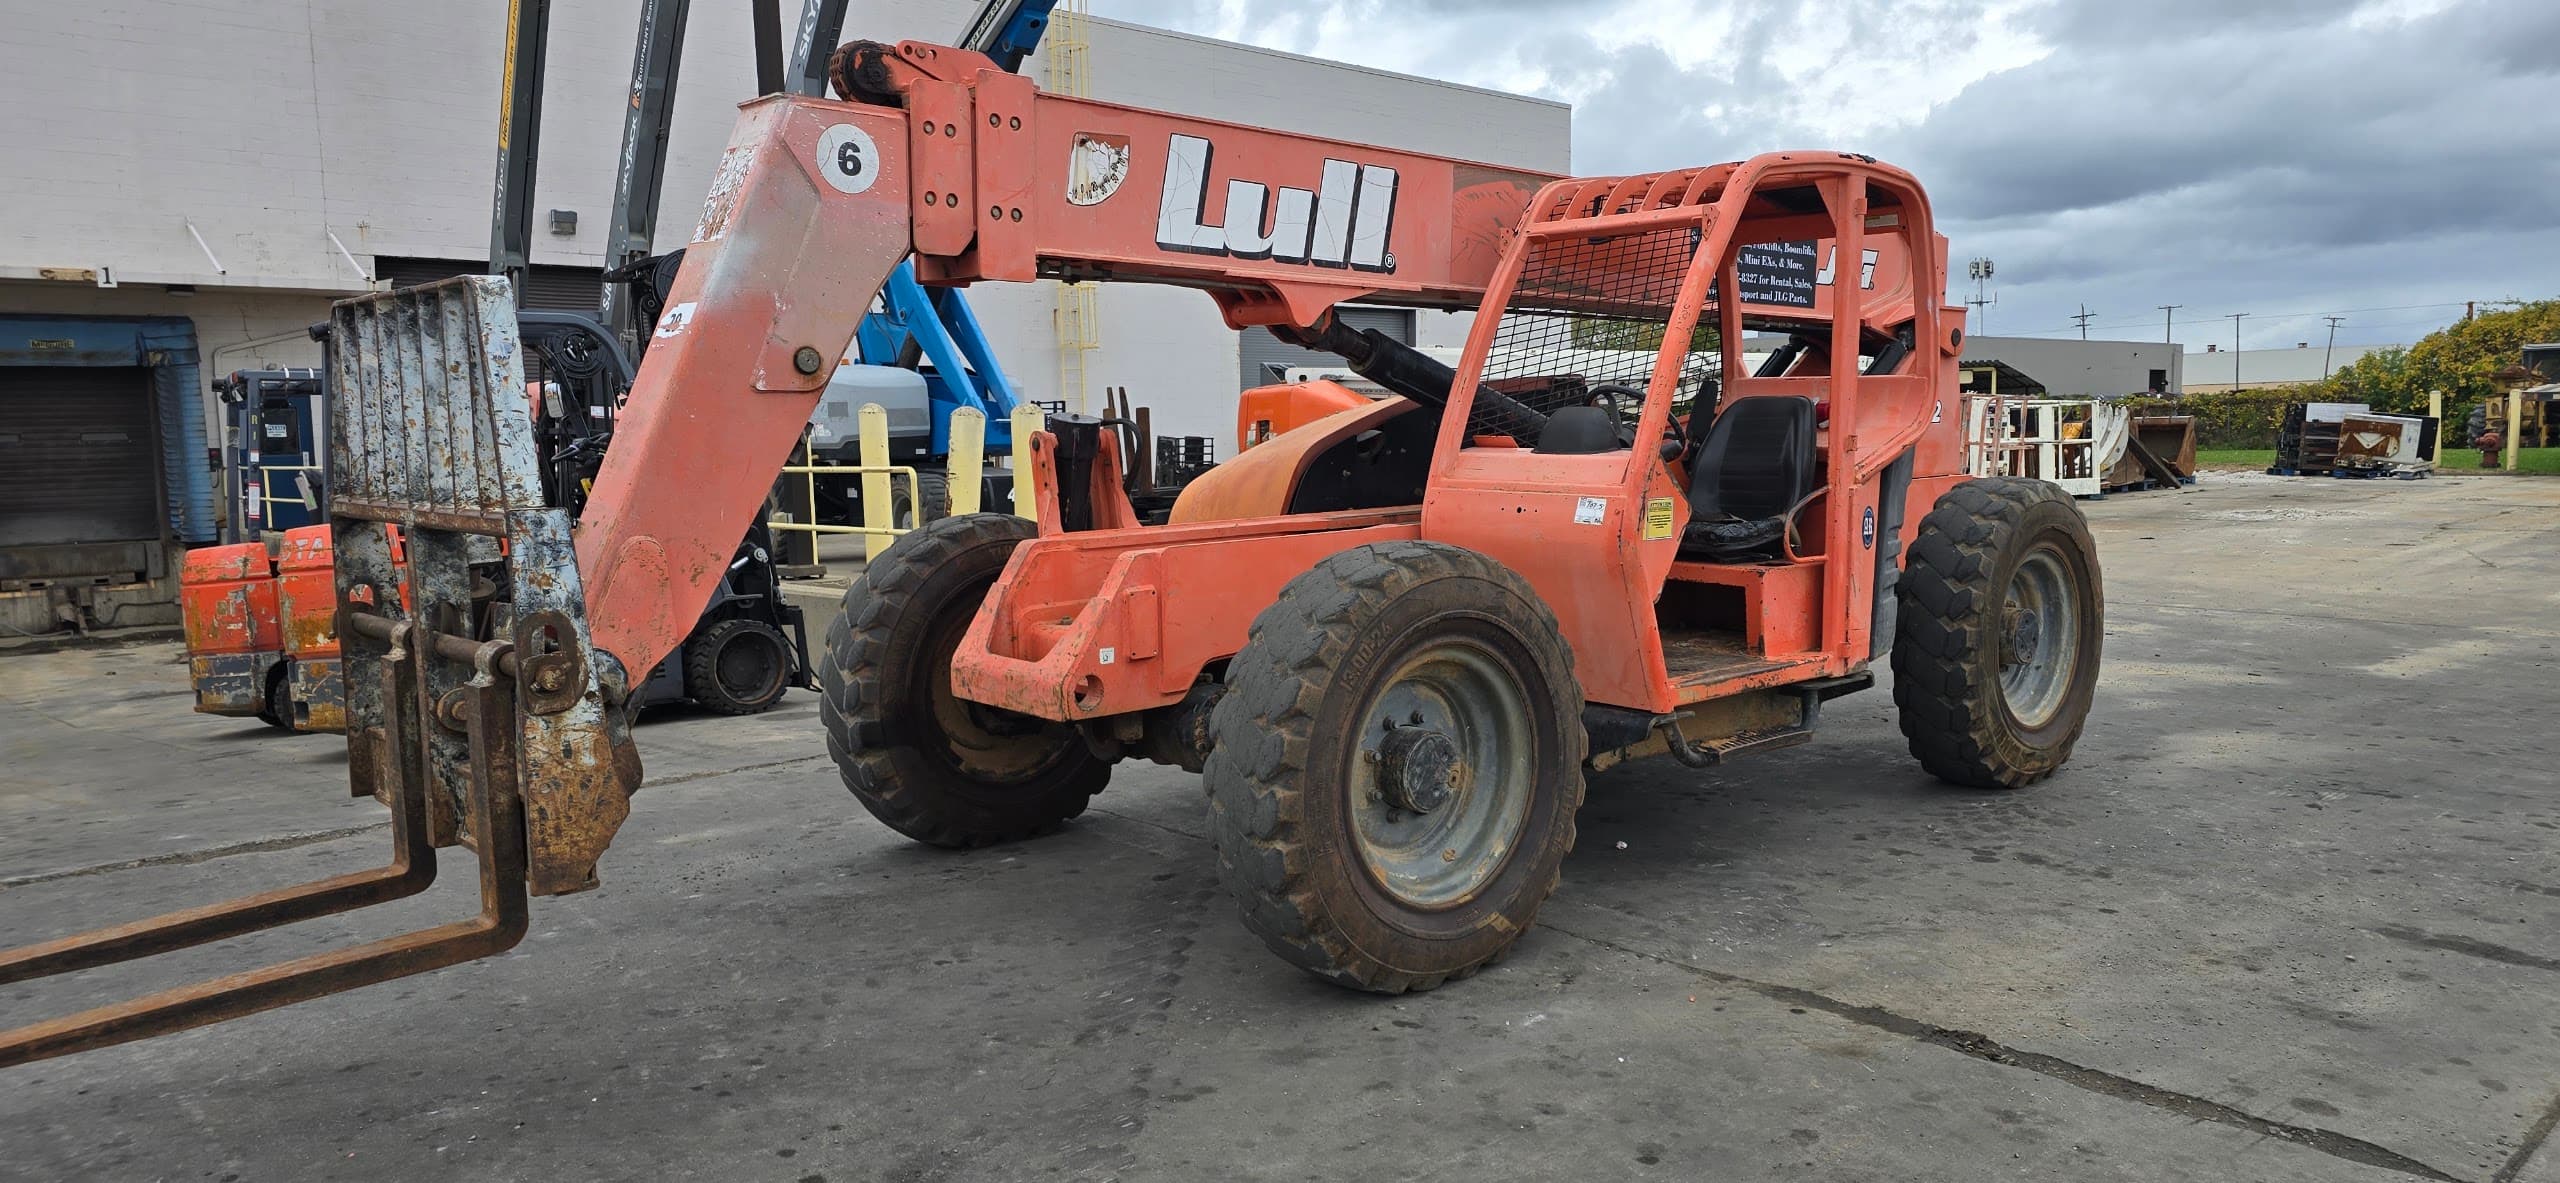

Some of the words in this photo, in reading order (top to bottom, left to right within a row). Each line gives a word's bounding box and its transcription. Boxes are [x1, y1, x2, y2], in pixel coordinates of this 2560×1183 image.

[621, 114, 638, 195] SKYJACK
[837, 141, 862, 177] 6
[496, 151, 505, 221] SKYJACK
[1155, 132, 1399, 273] Lull
[1784, 242, 1817, 257] Boomlifts,
[1744, 253, 1760, 265] Mini
[1778, 258, 1785, 268] &
[1786, 258, 1805, 270] More.
[1816, 244, 1879, 290] JG
[102, 266, 113, 285] 1
[1759, 274, 1769, 285] for
[1770, 275, 1793, 289] Rental,
[1794, 278, 1812, 290] Sales,
[1760, 290, 1773, 301] and
[1774, 290, 1788, 302] JLG
[1789, 292, 1808, 304] Parts.
[251, 414, 258, 425] R
